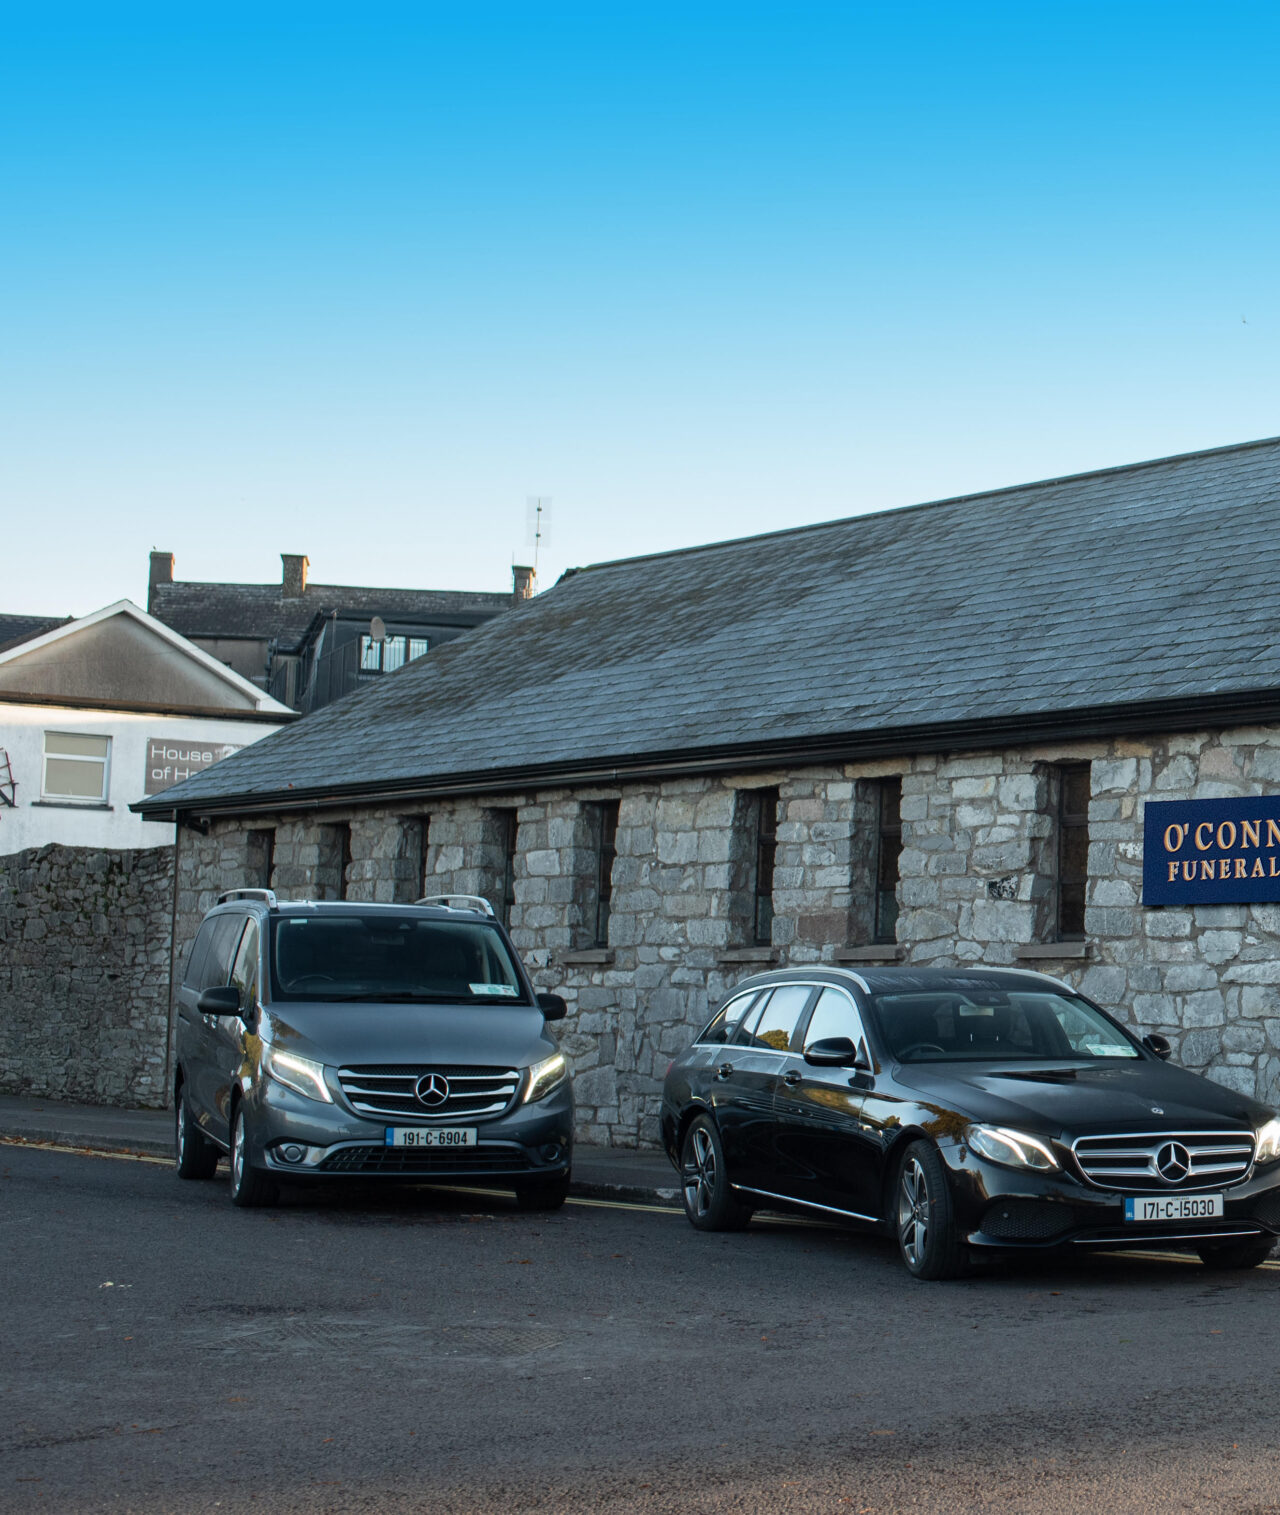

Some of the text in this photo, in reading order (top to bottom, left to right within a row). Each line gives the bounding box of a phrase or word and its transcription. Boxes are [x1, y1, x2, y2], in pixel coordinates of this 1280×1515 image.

[151, 745, 213, 762] House
[152, 766, 171, 780] of
[403, 1131, 468, 1145] 191-C-6904
[1143, 1199, 1215, 1219] 171-C-15030
